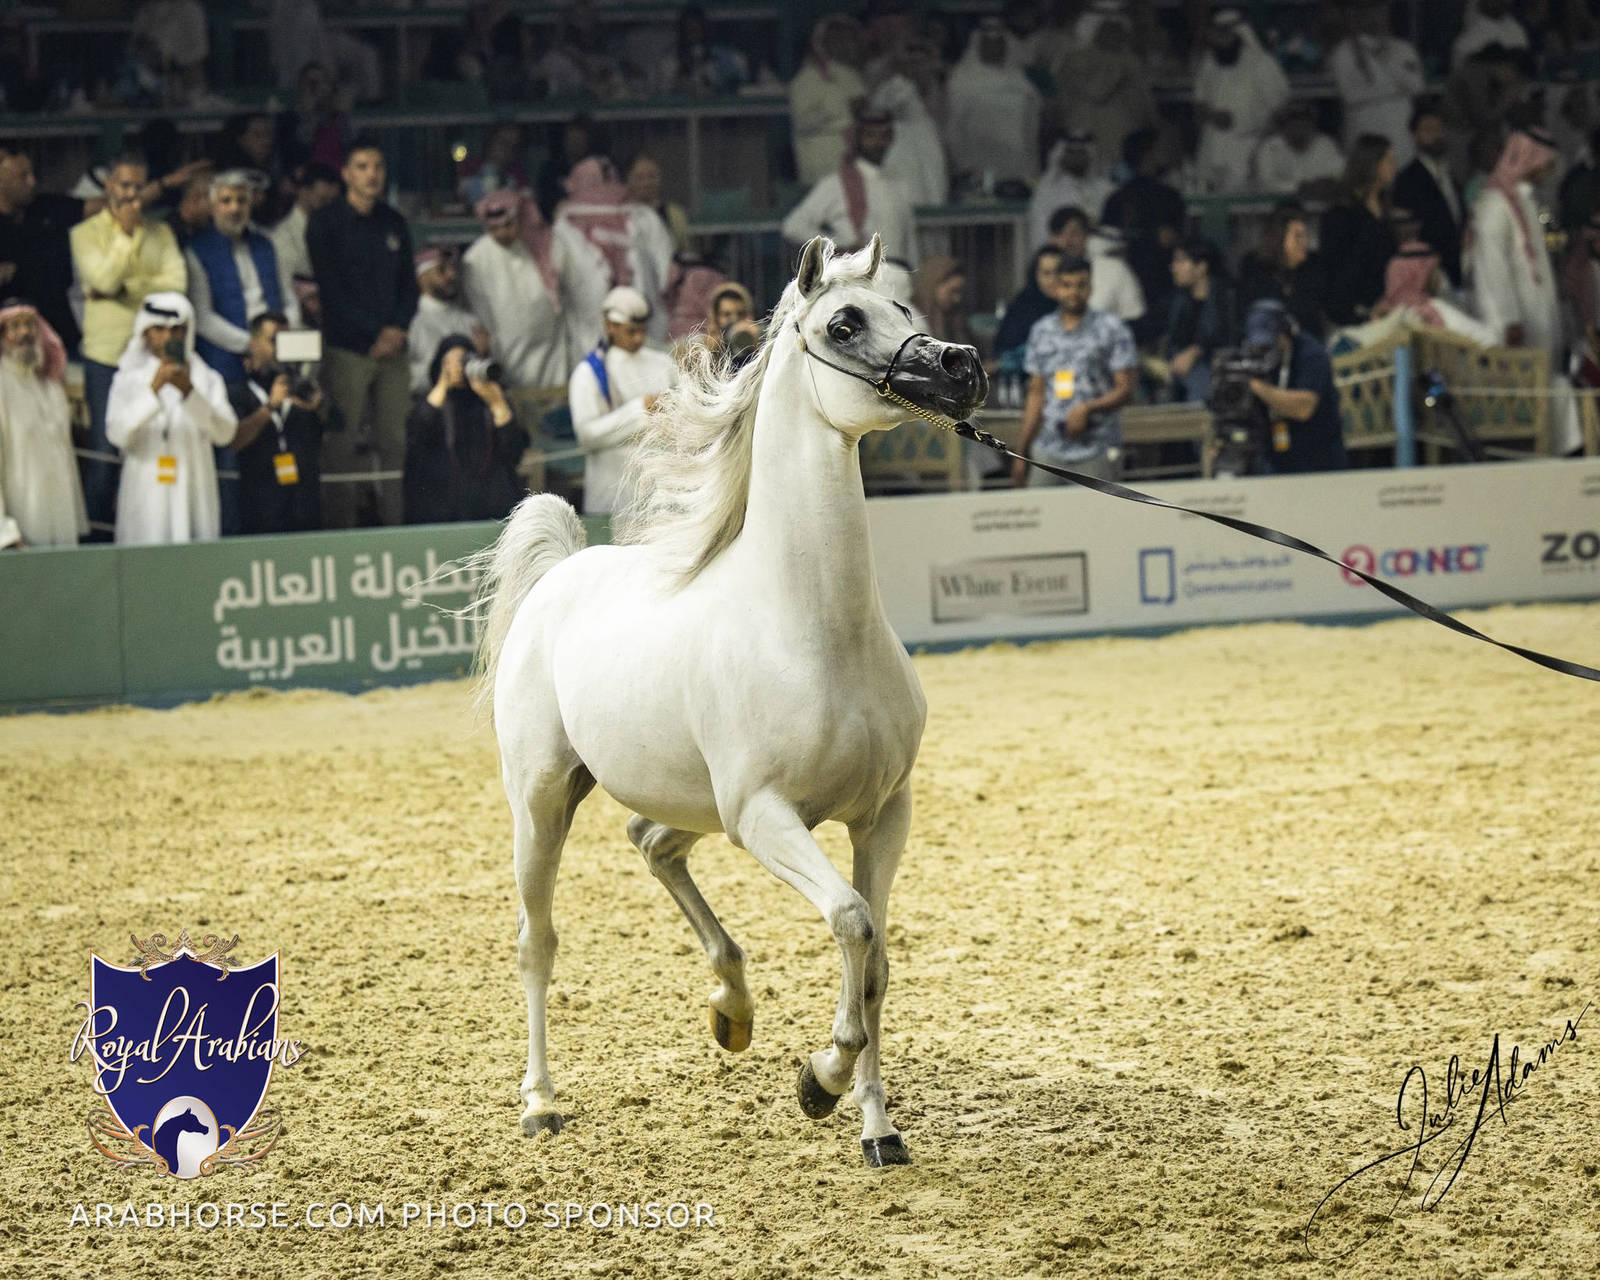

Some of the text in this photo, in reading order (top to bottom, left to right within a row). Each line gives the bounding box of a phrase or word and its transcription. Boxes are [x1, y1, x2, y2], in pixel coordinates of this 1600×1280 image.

[213, 554, 336, 623] العالم
[939, 569, 1068, 598] White Event
[216, 614, 355, 681] العربية
